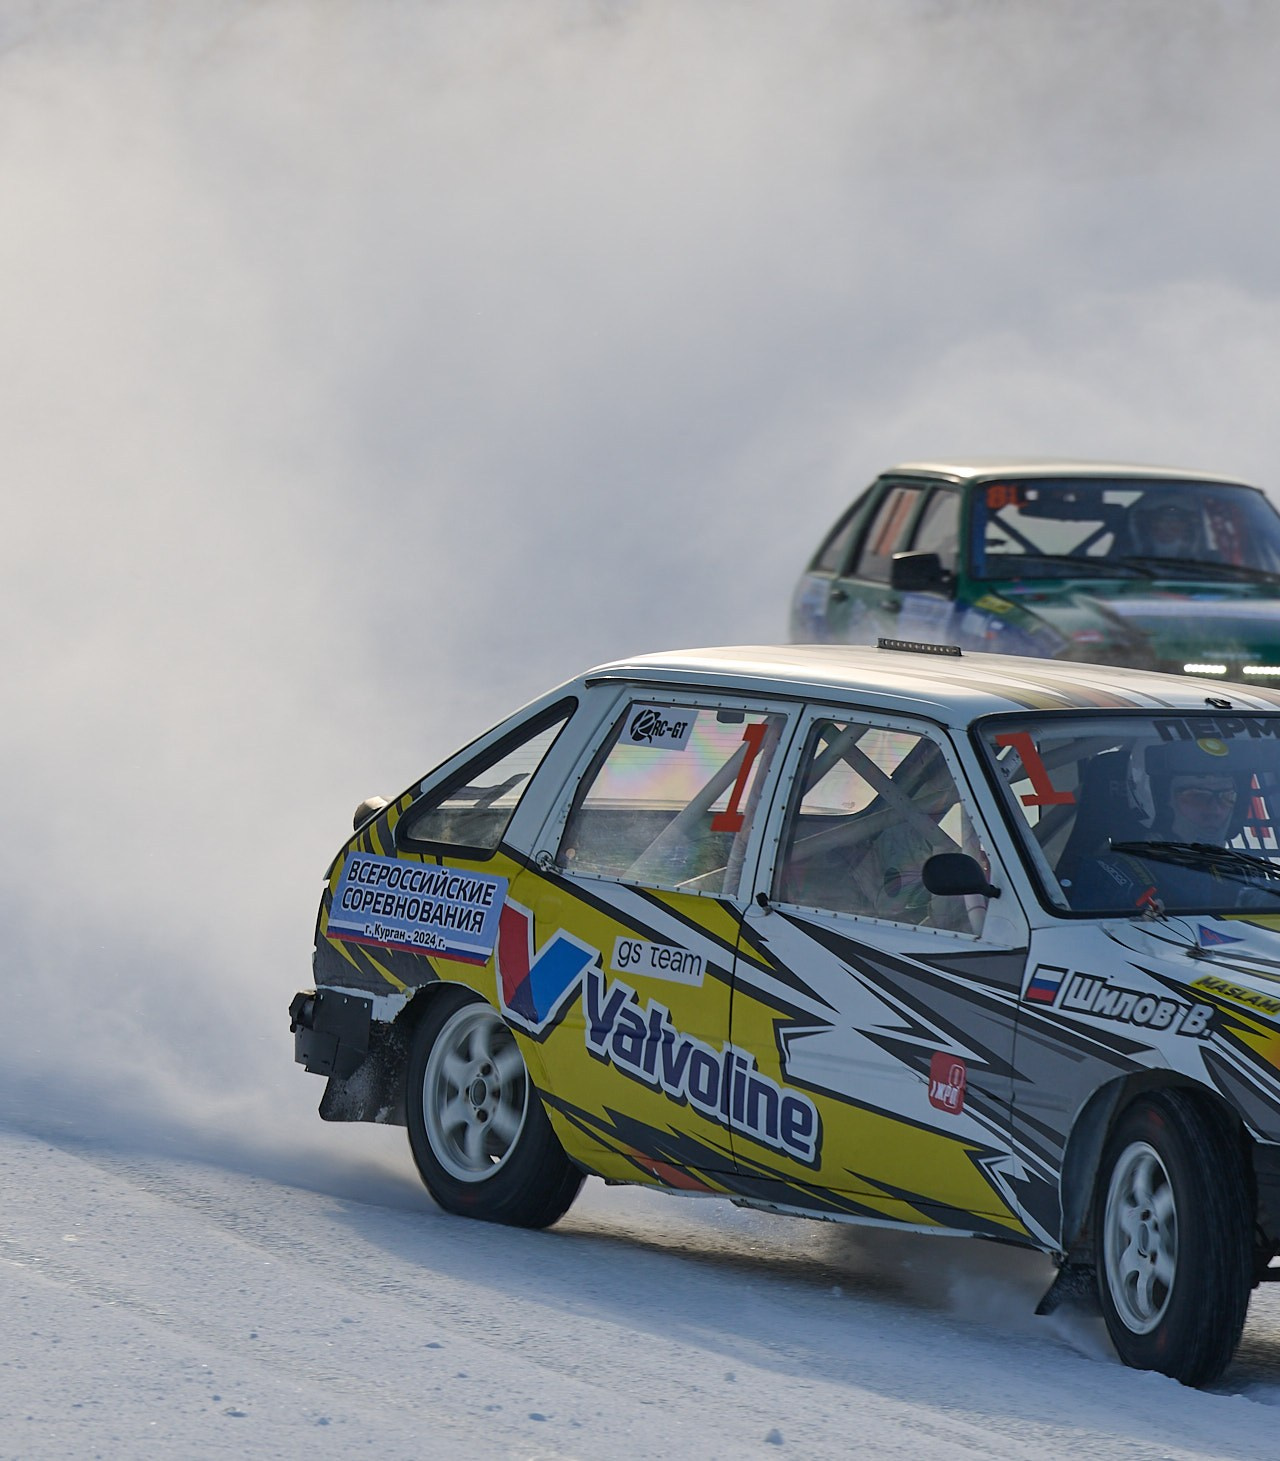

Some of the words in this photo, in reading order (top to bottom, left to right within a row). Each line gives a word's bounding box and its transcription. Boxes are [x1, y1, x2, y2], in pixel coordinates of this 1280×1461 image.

[710, 724, 768, 832] 1
[993, 731, 1076, 806] 1
[347, 860, 496, 906] ВСЕРОССИЙСКИЕ
[342, 888, 485, 934] СОРЕВНОВАНИЯ
[365, 925, 373, 936] г.
[374, 923, 406, 943] Курган
[413, 931, 436, 946] 2024
[437, 938, 447, 950] г.
[617, 940, 643, 968] gs
[651, 946, 702, 976] team
[584, 968, 816, 1158] Valvoline
